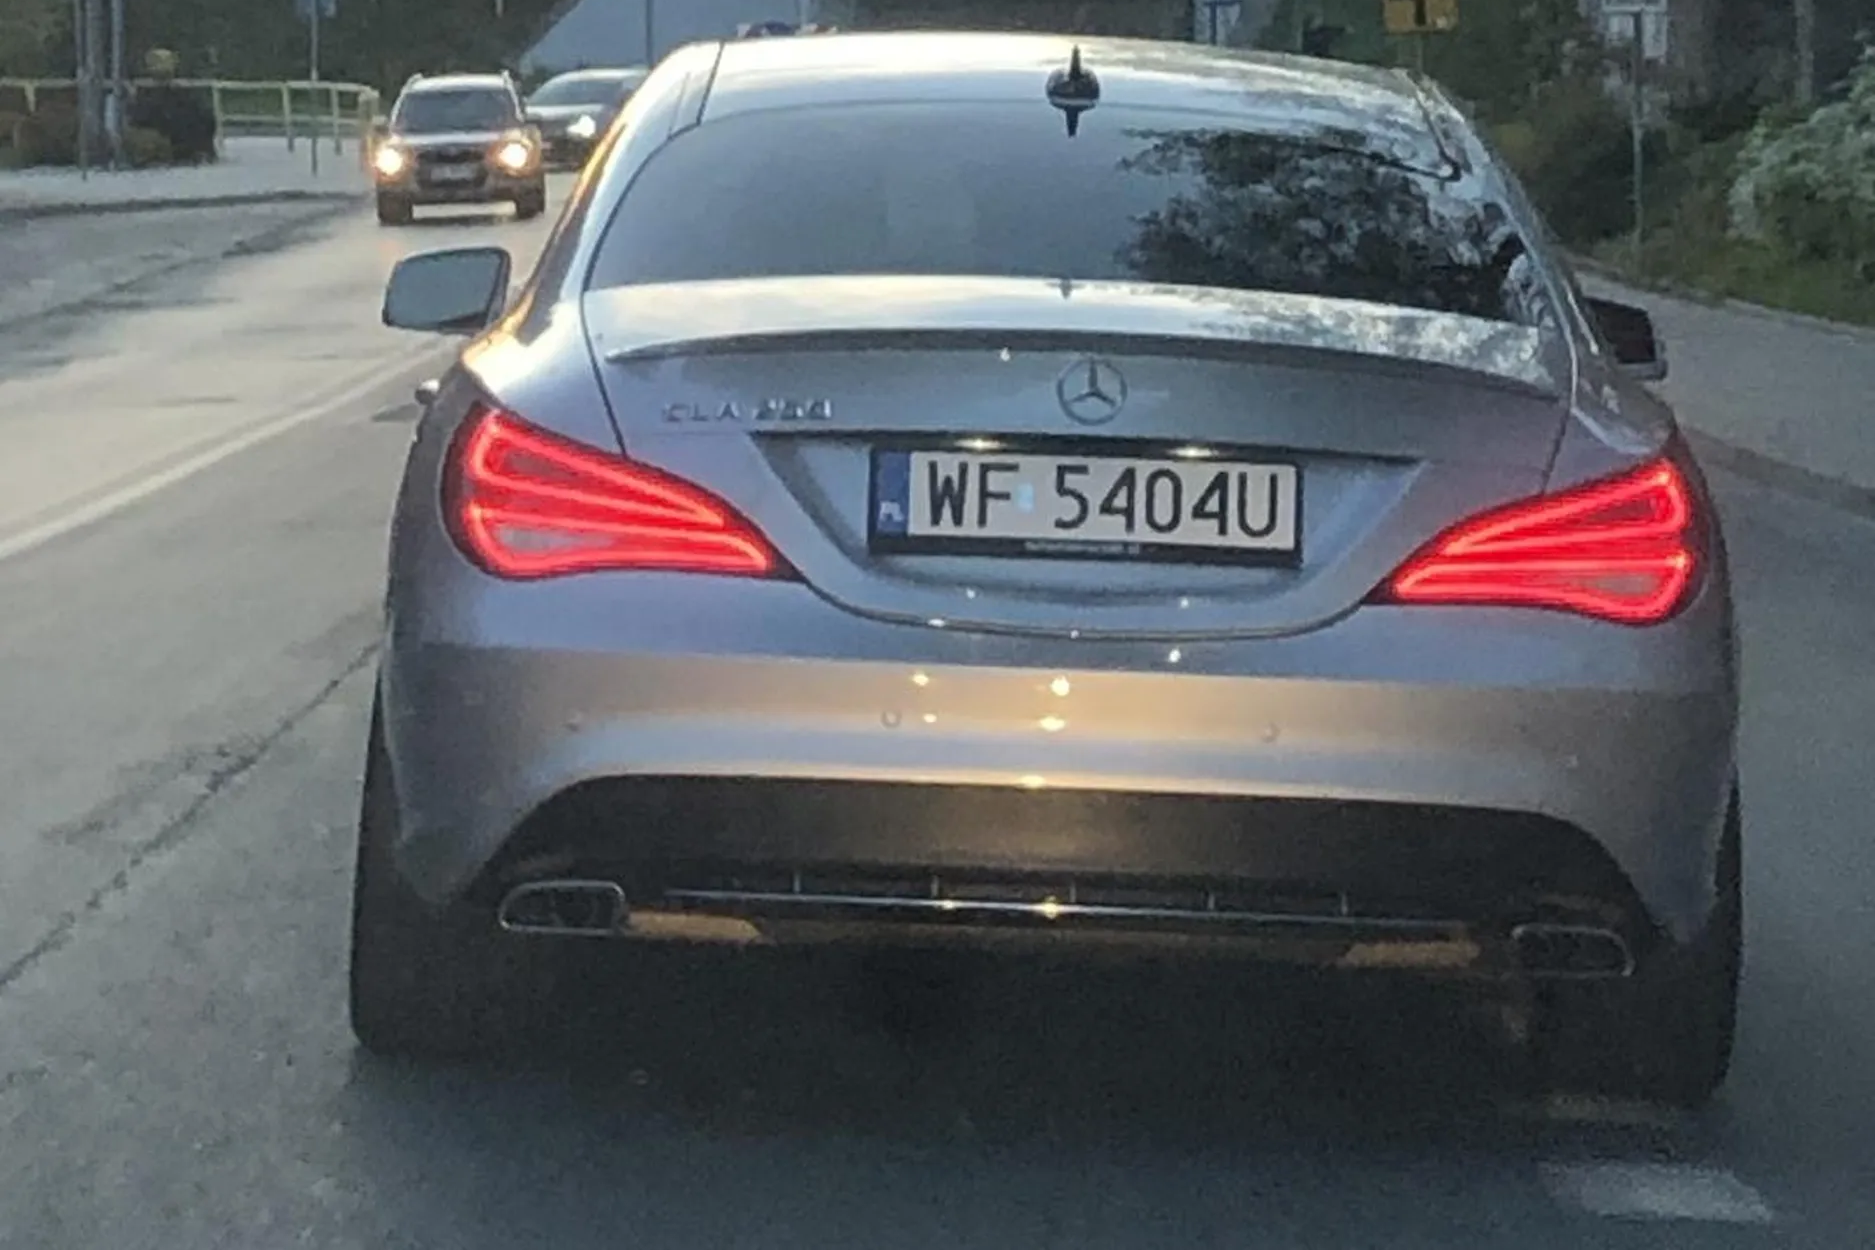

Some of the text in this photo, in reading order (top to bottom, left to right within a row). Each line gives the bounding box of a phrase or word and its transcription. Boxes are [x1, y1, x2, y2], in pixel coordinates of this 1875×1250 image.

[662, 401, 740, 423] CLA
[928, 460, 1279, 538] WF 5404U
